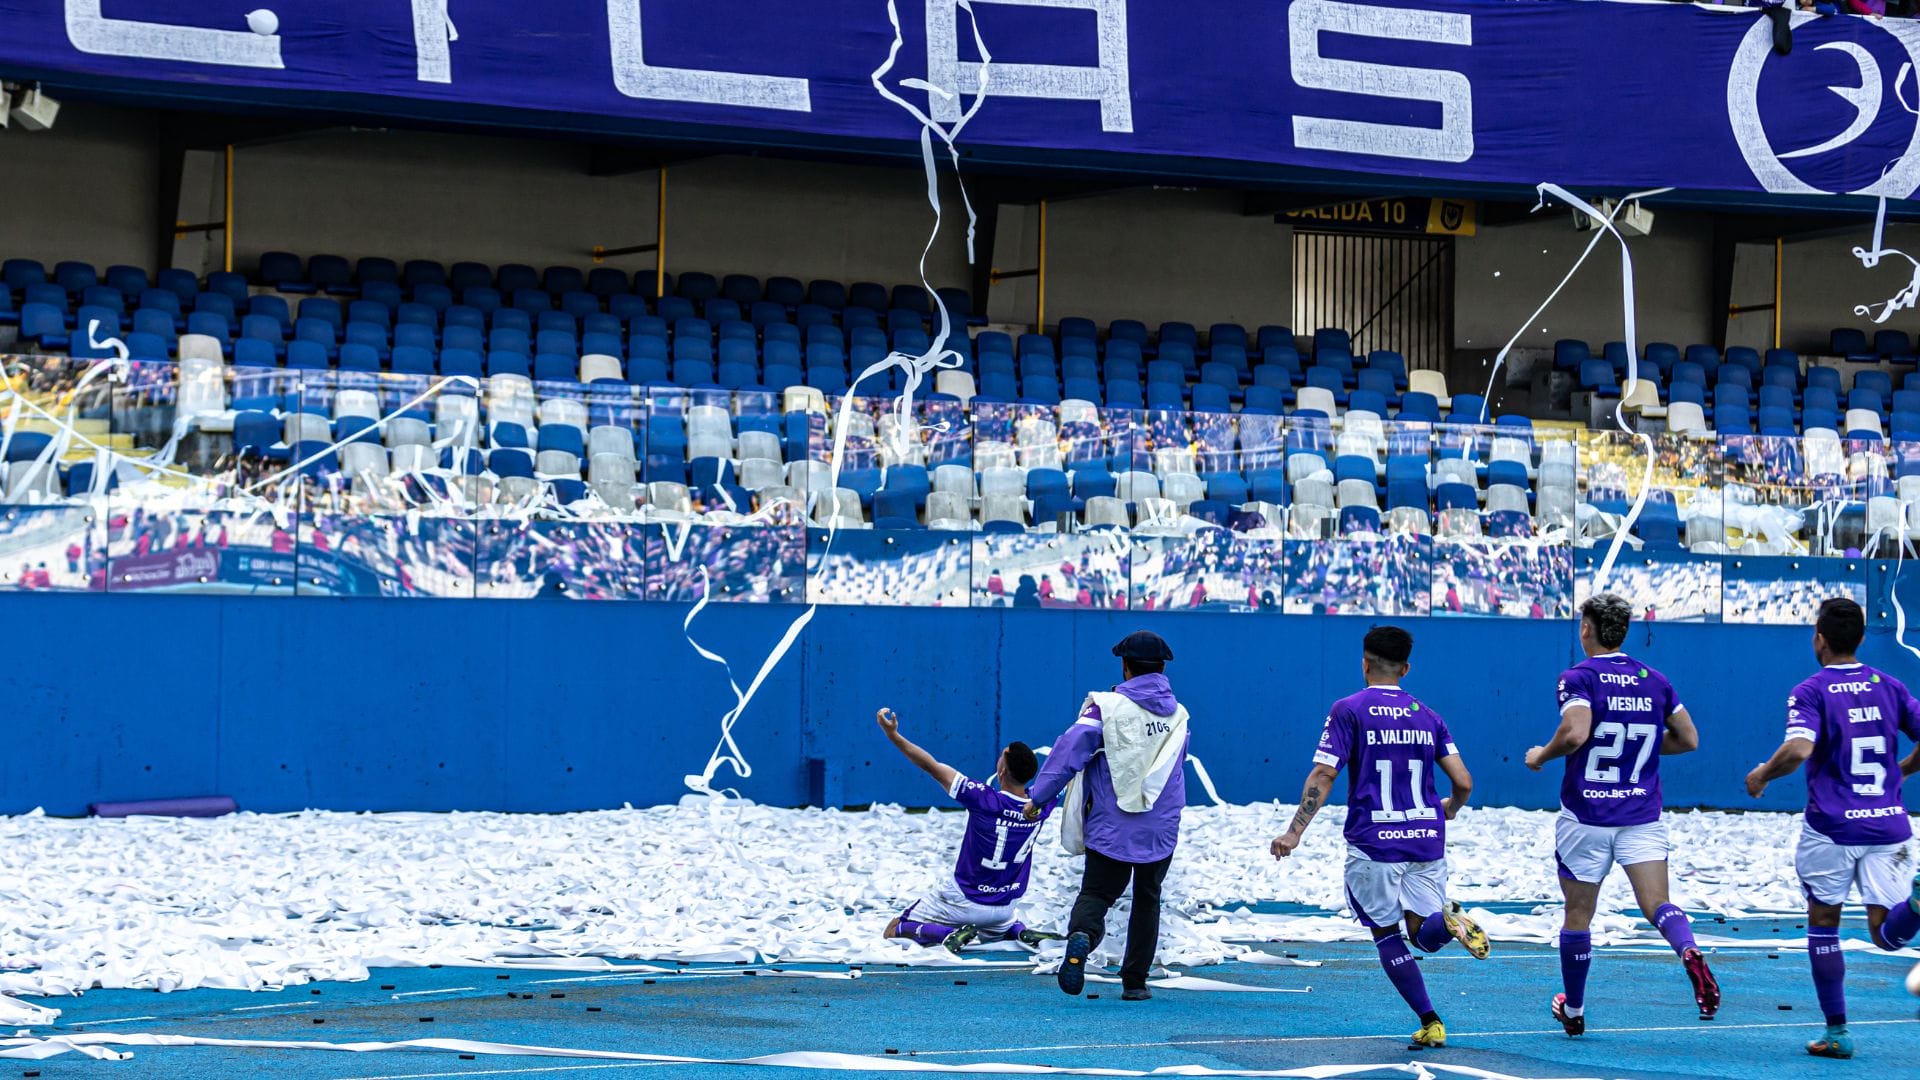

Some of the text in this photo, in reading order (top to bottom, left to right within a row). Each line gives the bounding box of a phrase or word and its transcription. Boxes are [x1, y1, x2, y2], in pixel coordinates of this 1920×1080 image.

[1380, 199, 1407, 224] 10
[1599, 672, 1640, 687] cmpc
[1827, 681, 1873, 695] cmpc
[1368, 705, 1412, 720] cmpc
[1848, 706, 1883, 723] SILVA
[1145, 721, 1171, 737] 2106
[1366, 729, 1435, 746] B.VALDIVIA
[1584, 721, 1658, 784] 27
[1850, 735, 1888, 796] 5
[1371, 759, 1438, 823] 11
[1378, 828, 1427, 840] COOLBET
